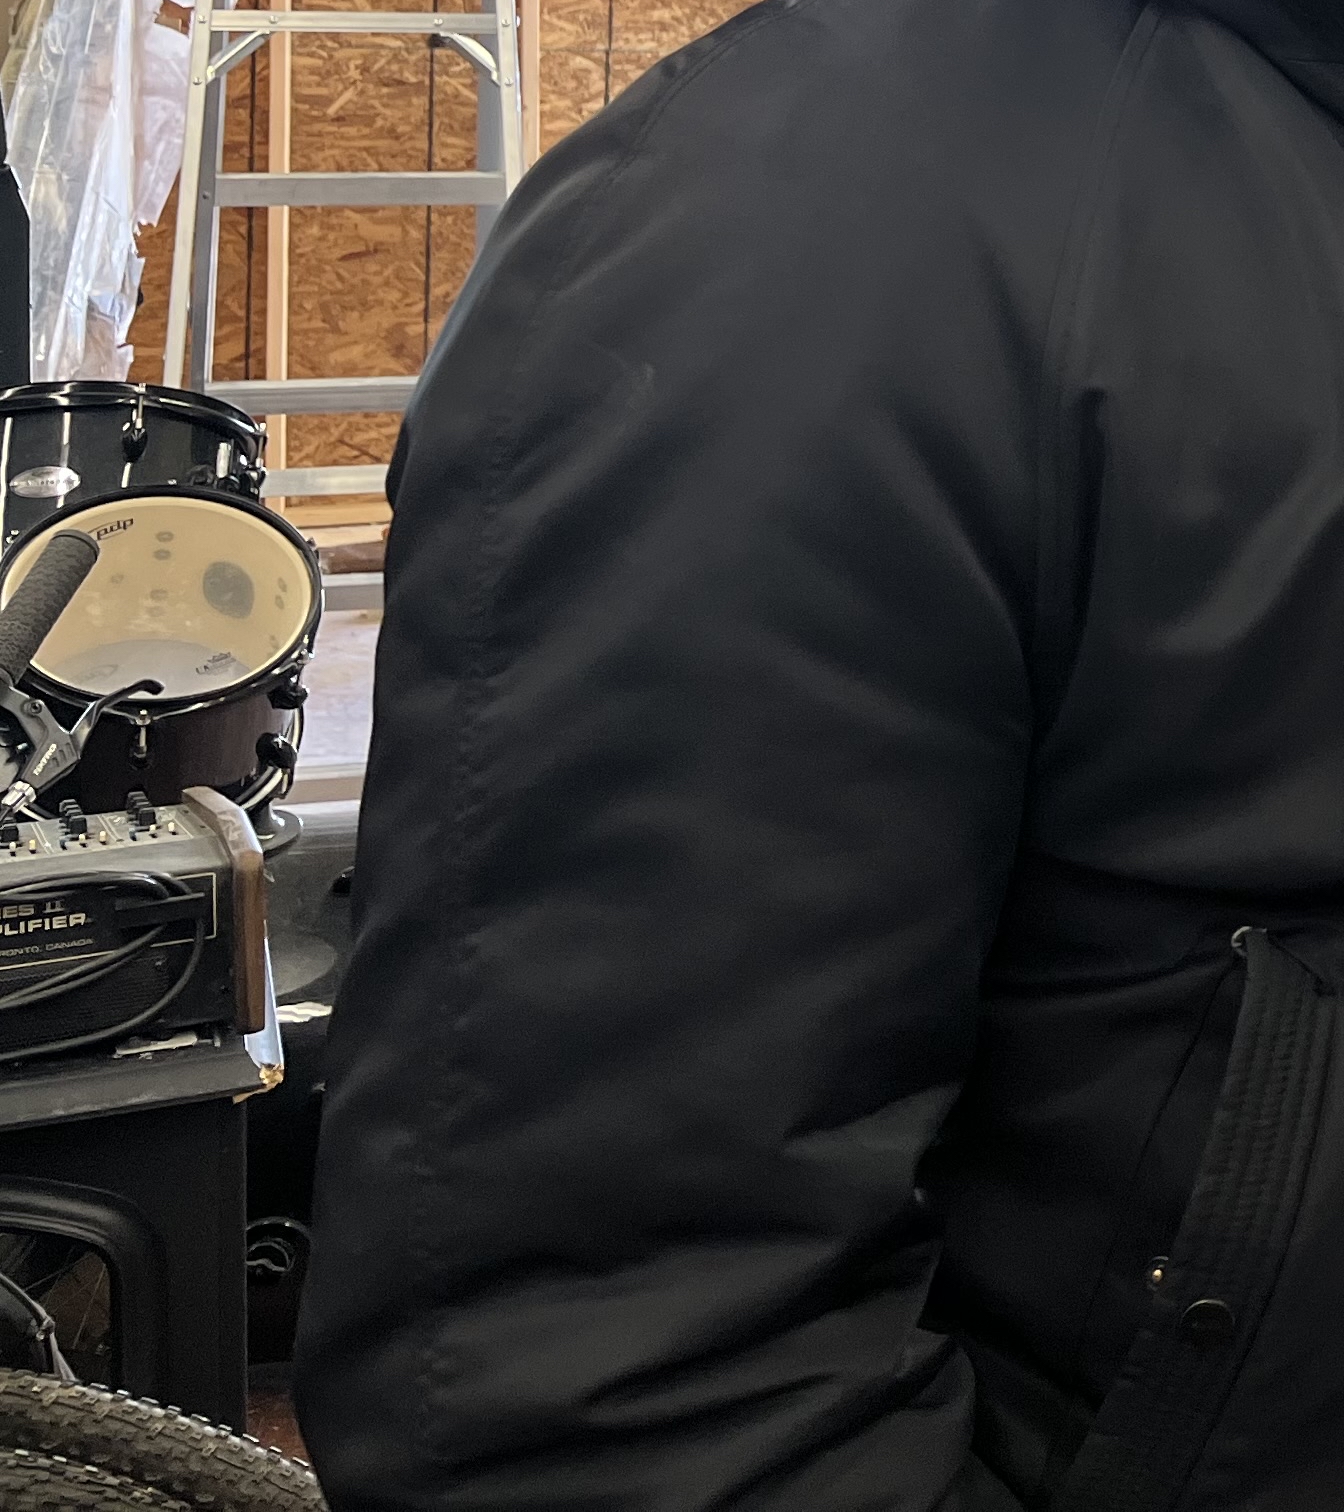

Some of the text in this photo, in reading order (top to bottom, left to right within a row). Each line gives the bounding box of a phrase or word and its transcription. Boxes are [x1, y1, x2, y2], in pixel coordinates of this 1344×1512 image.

[0, 904, 35, 919] ES
[0, 913, 87, 936] LIFIER
[45, 938, 94, 952] CANADA
